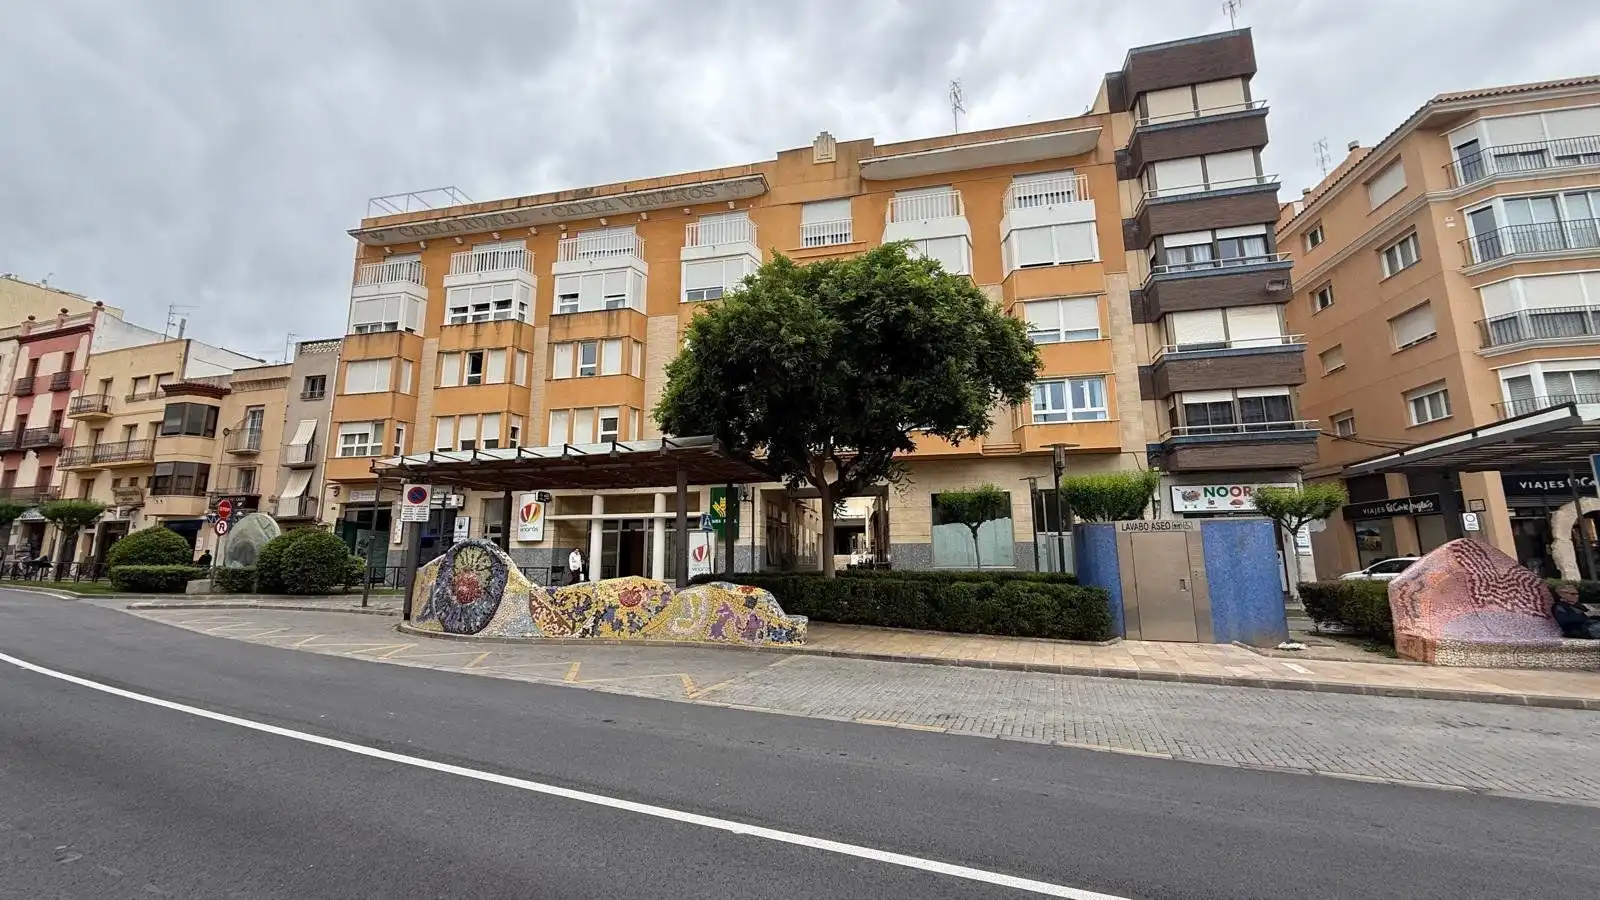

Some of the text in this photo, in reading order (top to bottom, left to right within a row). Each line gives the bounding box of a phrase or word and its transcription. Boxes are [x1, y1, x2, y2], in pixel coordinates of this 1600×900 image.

[1519, 481, 1565, 490] VIAJES
[1203, 486, 1252, 497] NOOR
[1362, 507, 1386, 515] VIAJES
[1121, 521, 1171, 532] LAVABO ASEO
